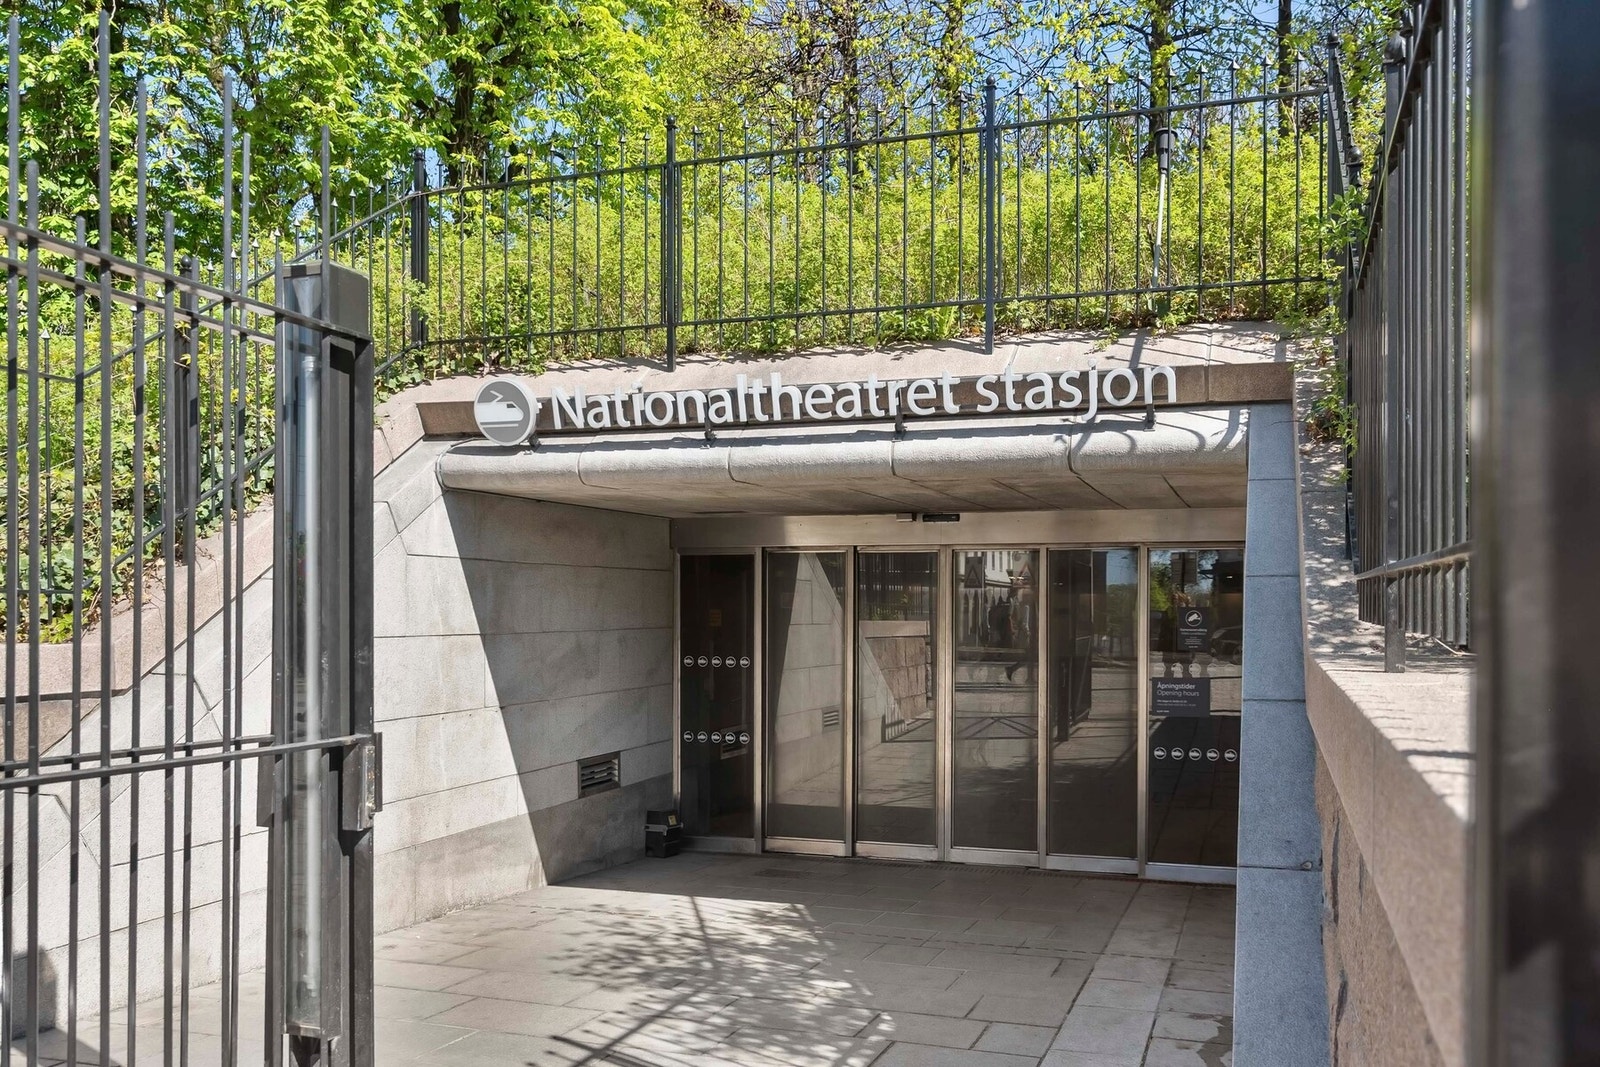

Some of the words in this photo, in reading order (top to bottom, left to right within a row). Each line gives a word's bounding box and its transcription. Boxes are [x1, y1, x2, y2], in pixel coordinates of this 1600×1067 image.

[551, 372, 960, 430] Nationaltheatret
[975, 360, 1177, 421] stasjon
[1156, 681, 1196, 690] Åpningstider
